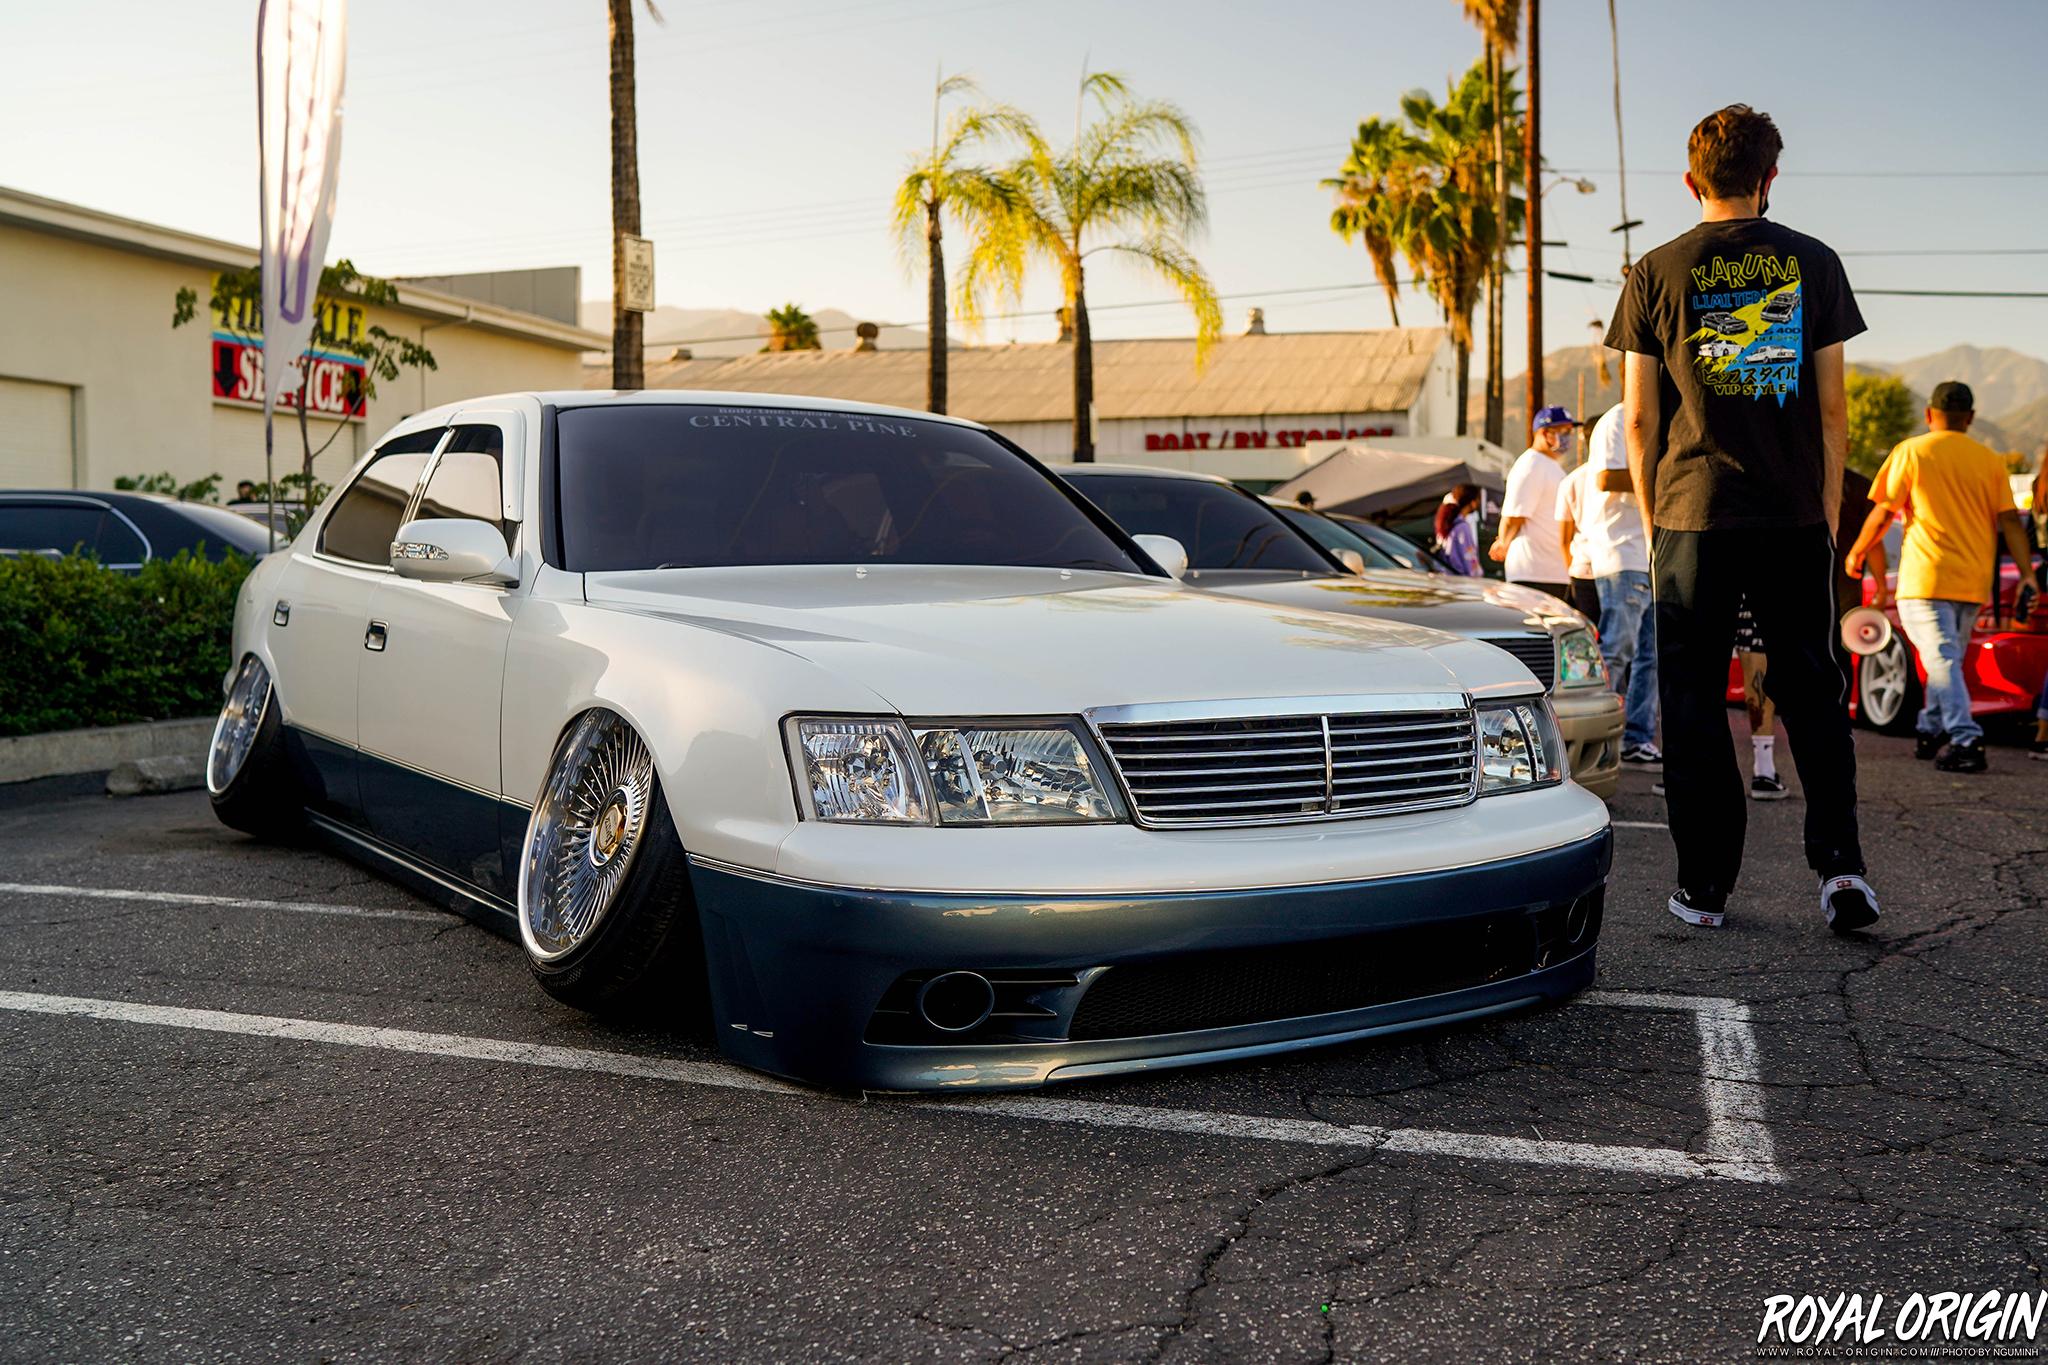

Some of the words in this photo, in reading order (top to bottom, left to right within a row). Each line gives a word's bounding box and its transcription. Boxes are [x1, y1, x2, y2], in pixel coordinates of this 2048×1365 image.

[1691, 254, 1802, 291] KARUMA
[1693, 289, 1768, 309] LIMITED!
[238, 347, 345, 414] SEICE
[1715, 385, 1741, 395] VIP
[1742, 383, 1787, 395] STYLE
[690, 414, 837, 430] CENTRAL
[847, 419, 917, 437] PINE
[1145, 433, 1210, 451] BOAT
[1235, 431, 1268, 450] RV
